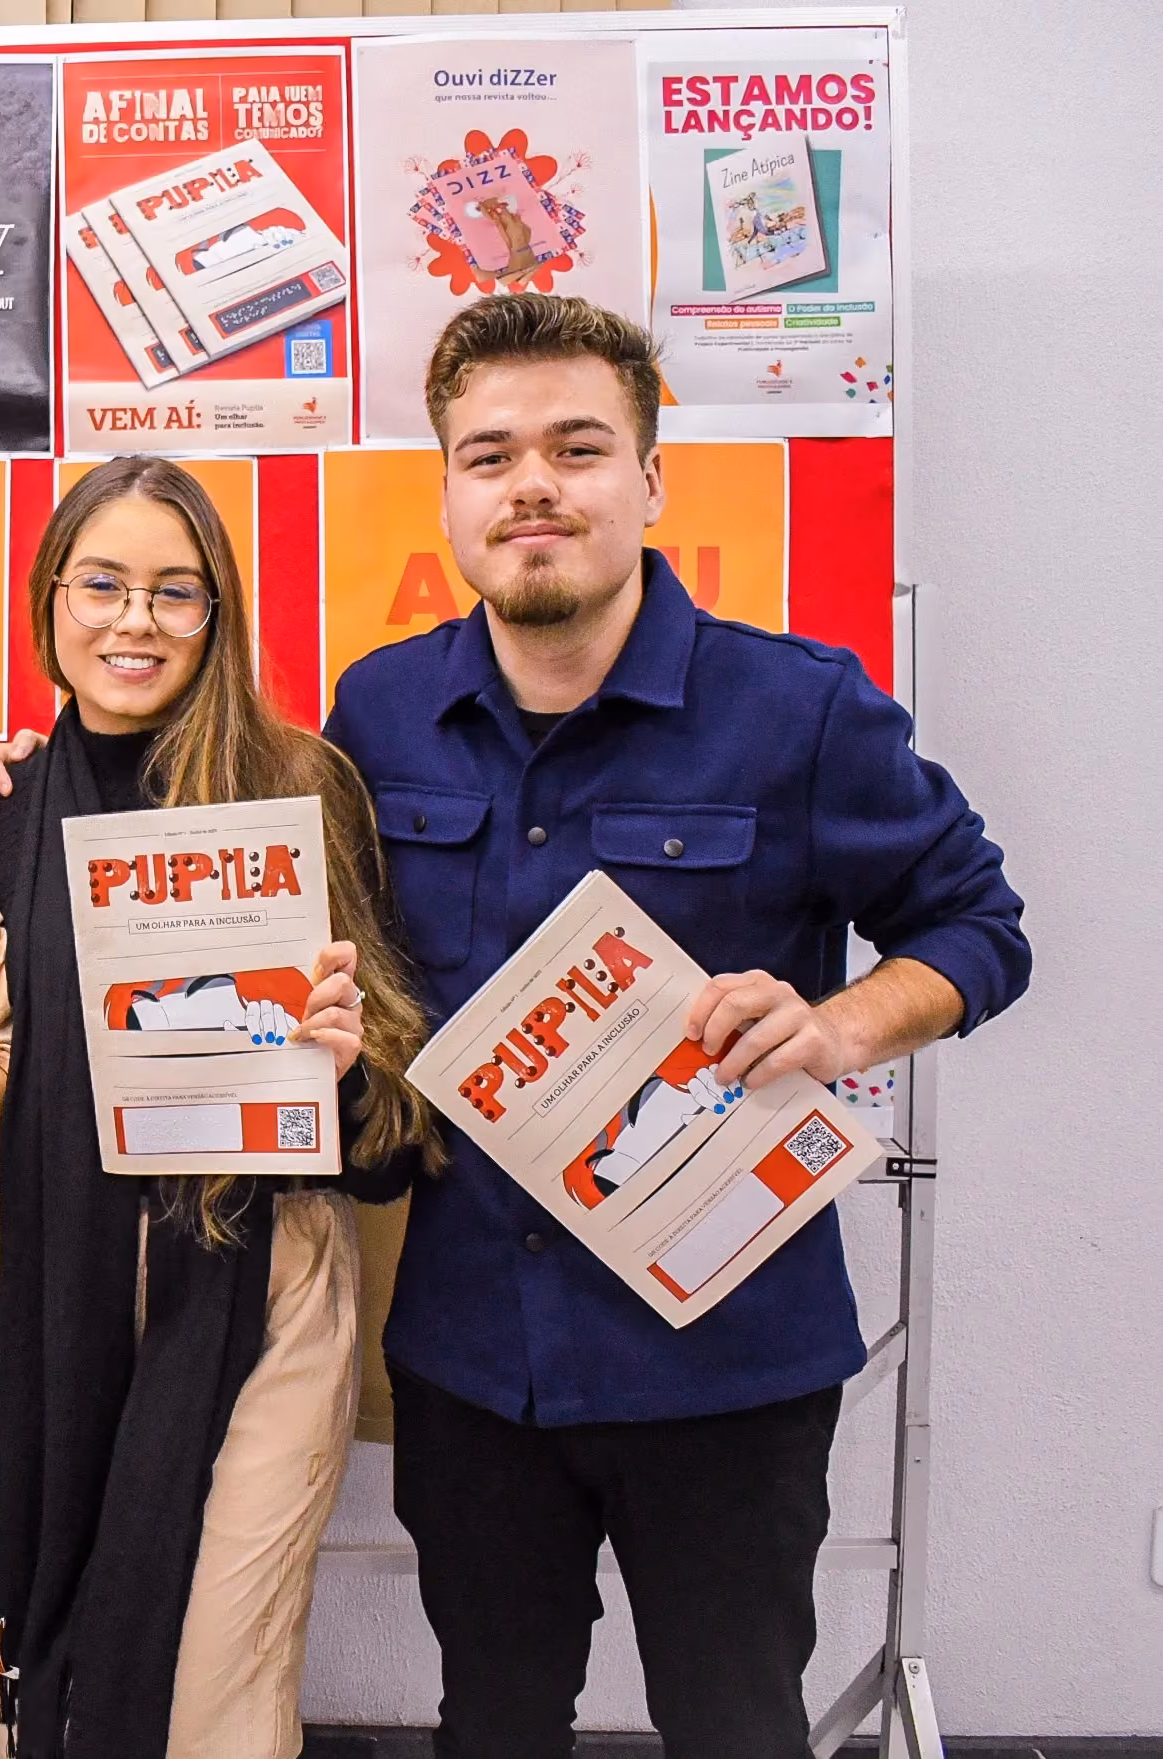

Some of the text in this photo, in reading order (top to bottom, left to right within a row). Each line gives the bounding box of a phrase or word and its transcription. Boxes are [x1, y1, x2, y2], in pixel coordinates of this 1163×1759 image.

[434, 68, 557, 87] Ouvi diZZer
[662, 73, 876, 107] ESTAMOS
[81, 87, 209, 122] AFINAL
[233, 101, 324, 128] TEMOS
[434, 94, 452, 103] que
[454, 93, 482, 101] nossa
[484, 92, 515, 101] revista
[81, 120, 209, 144] DE CONTAS
[663, 105, 873, 141] LANÇANDO!
[721, 154, 795, 188] Zine Atípica
[136, 158, 265, 221] PUPILA
[86, 399, 202, 431] VEM AÍ:
[385, 552, 464, 626] A
[88, 843, 303, 908] PUPILA
[135, 922, 150, 931] UM
[151, 920, 182, 930] OLHAR
[183, 918, 207, 928] PARA
[216, 914, 261, 925] INCLUSÃO
[457, 929, 654, 1124] PUPILA
[540, 1008, 640, 1109] UM OLHAR PARA A INCLUSÃO
